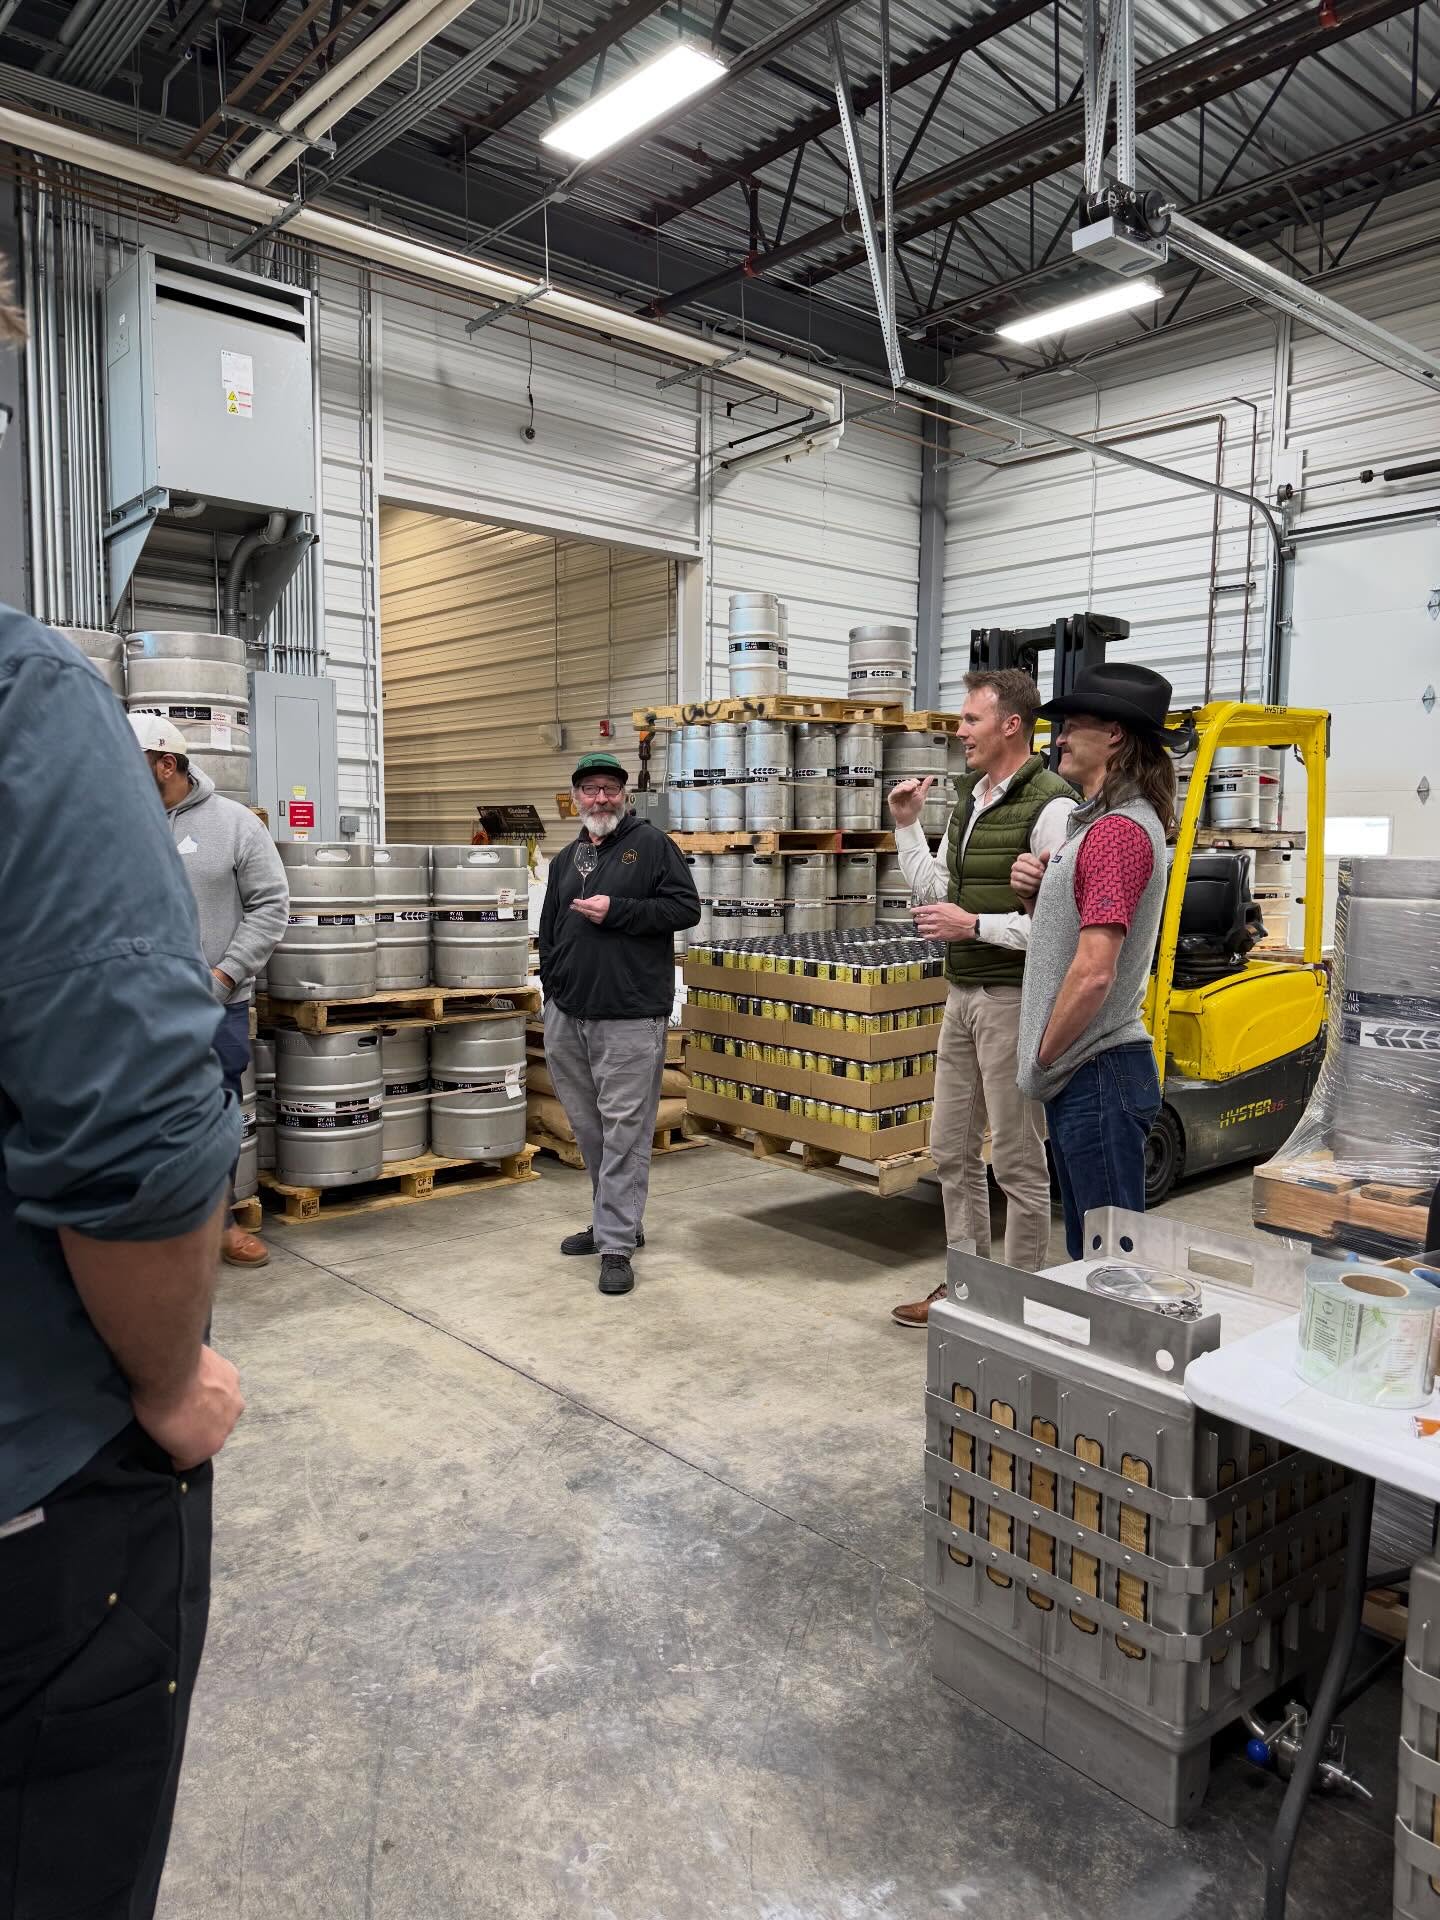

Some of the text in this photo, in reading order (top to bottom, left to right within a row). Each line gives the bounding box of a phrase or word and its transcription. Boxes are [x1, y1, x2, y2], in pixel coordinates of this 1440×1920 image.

[1264, 706, 1287, 715] HYSTER
[1220, 1098, 1272, 1129] HYSTER
[418, 1178, 427, 1187] CP
